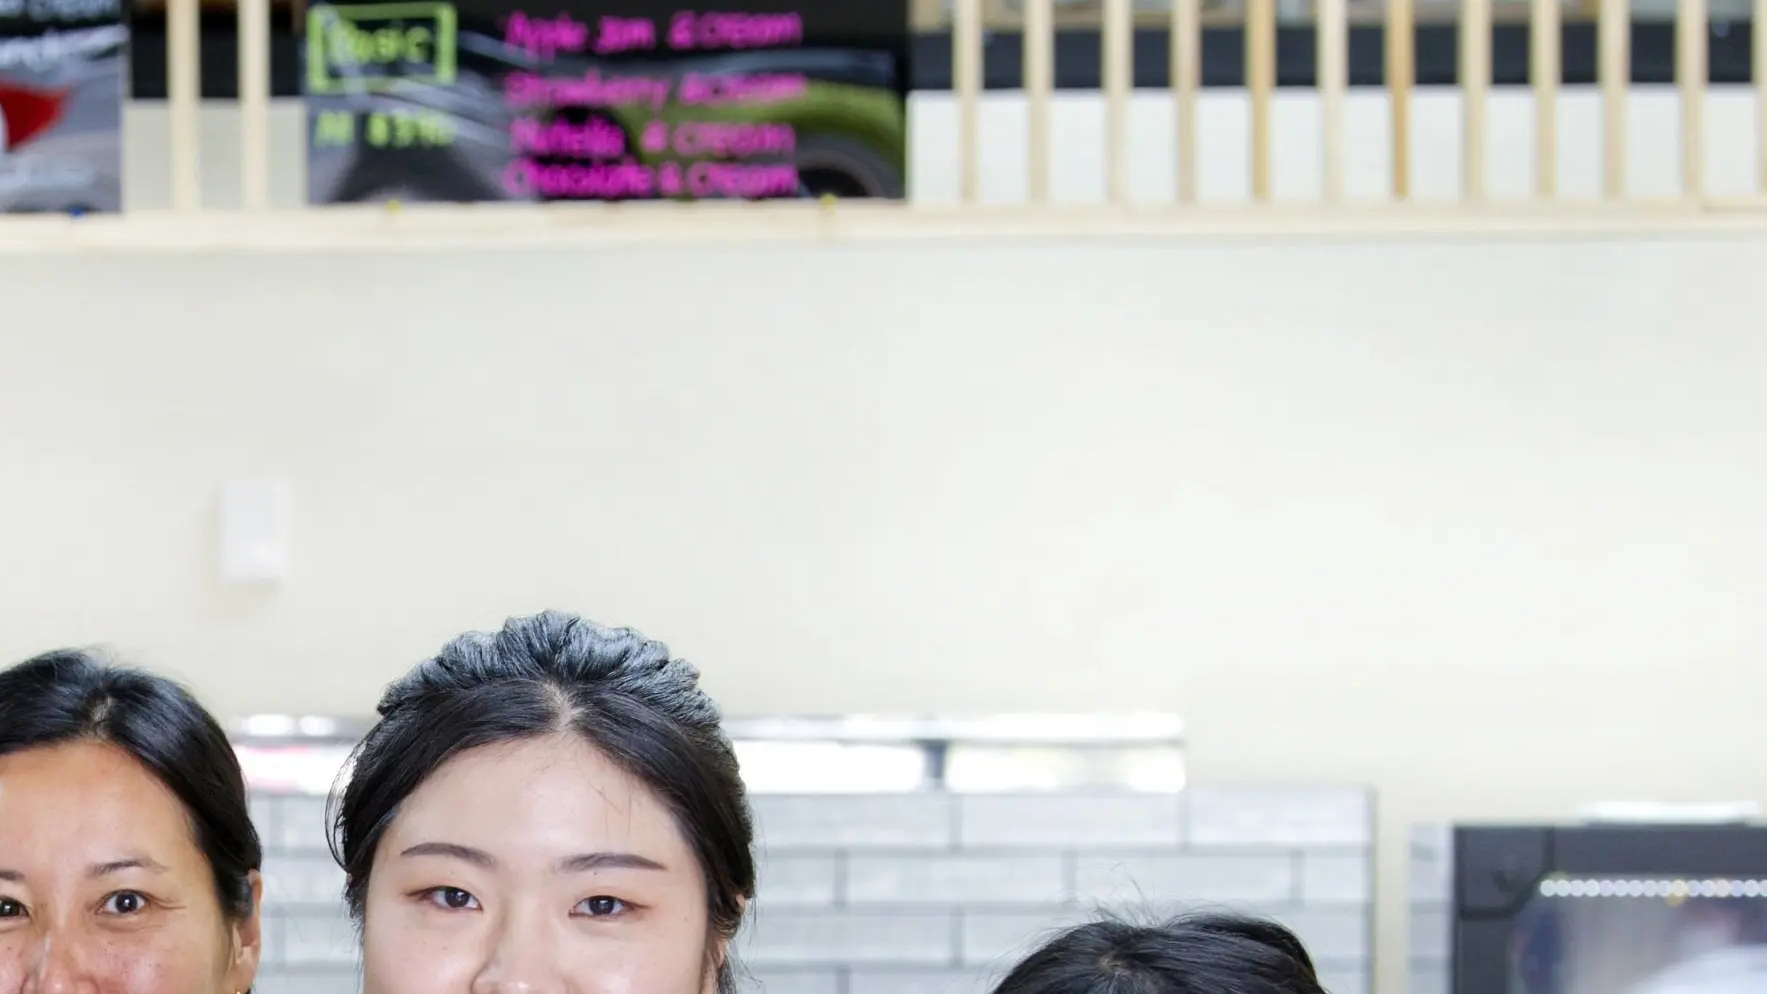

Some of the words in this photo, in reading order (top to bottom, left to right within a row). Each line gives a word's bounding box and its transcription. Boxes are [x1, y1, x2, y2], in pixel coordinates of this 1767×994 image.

[504, 10, 587, 62] Apple
[593, 15, 655, 53] Jam
[502, 159, 655, 197] Chocolate
